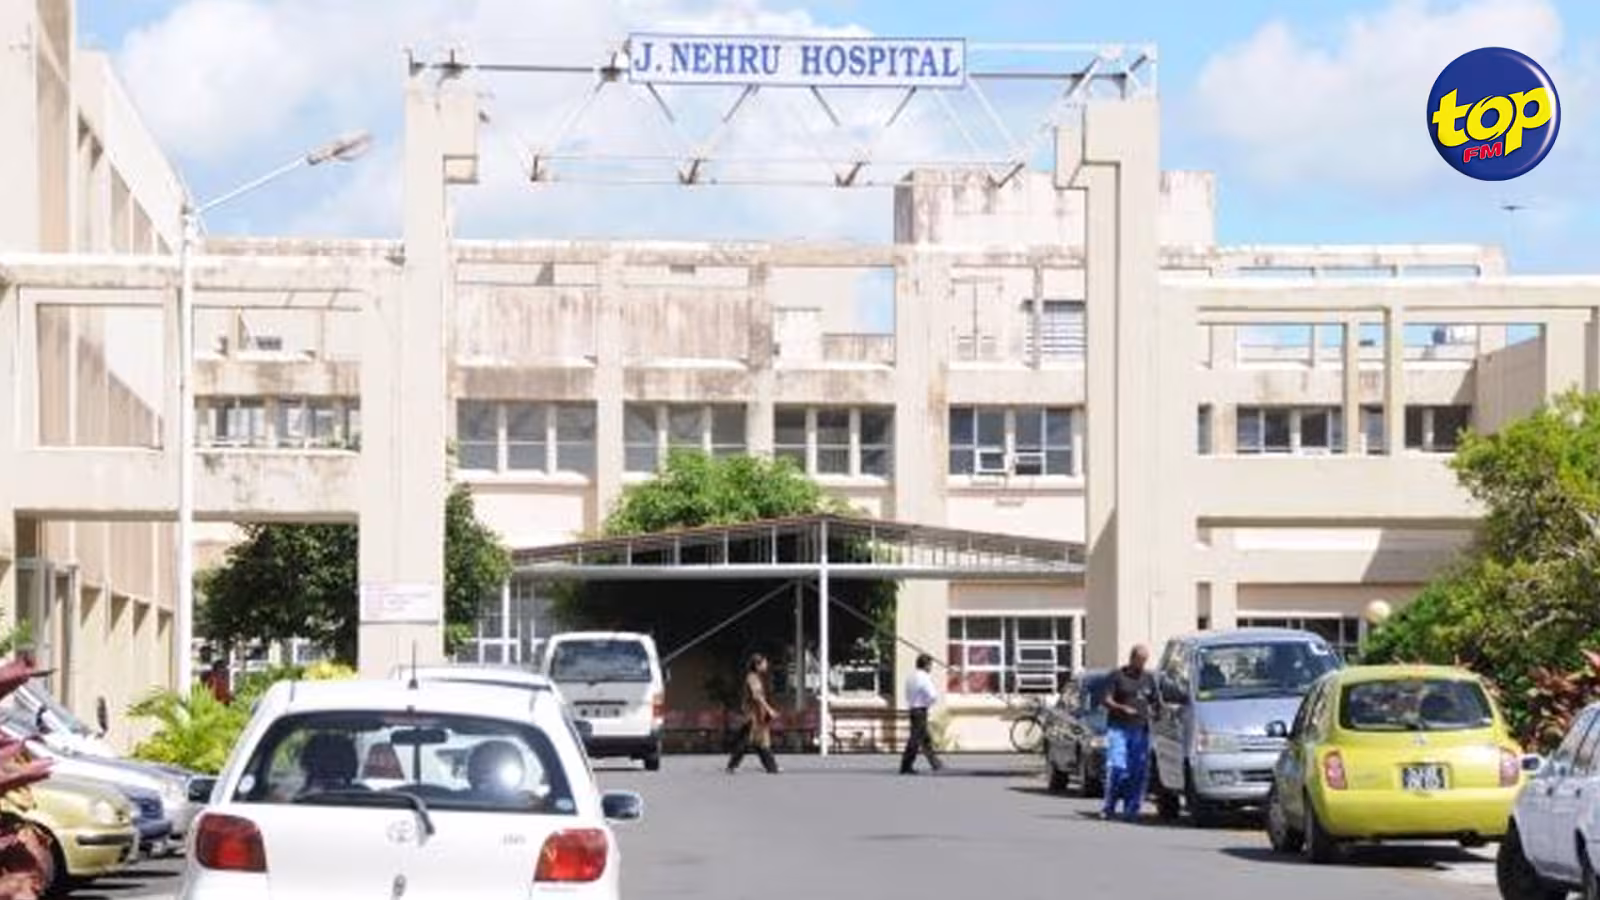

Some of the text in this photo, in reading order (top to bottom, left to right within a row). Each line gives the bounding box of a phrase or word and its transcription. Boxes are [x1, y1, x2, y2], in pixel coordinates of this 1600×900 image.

[634, 43, 960, 77] J. NEHRU HOSPITAL
